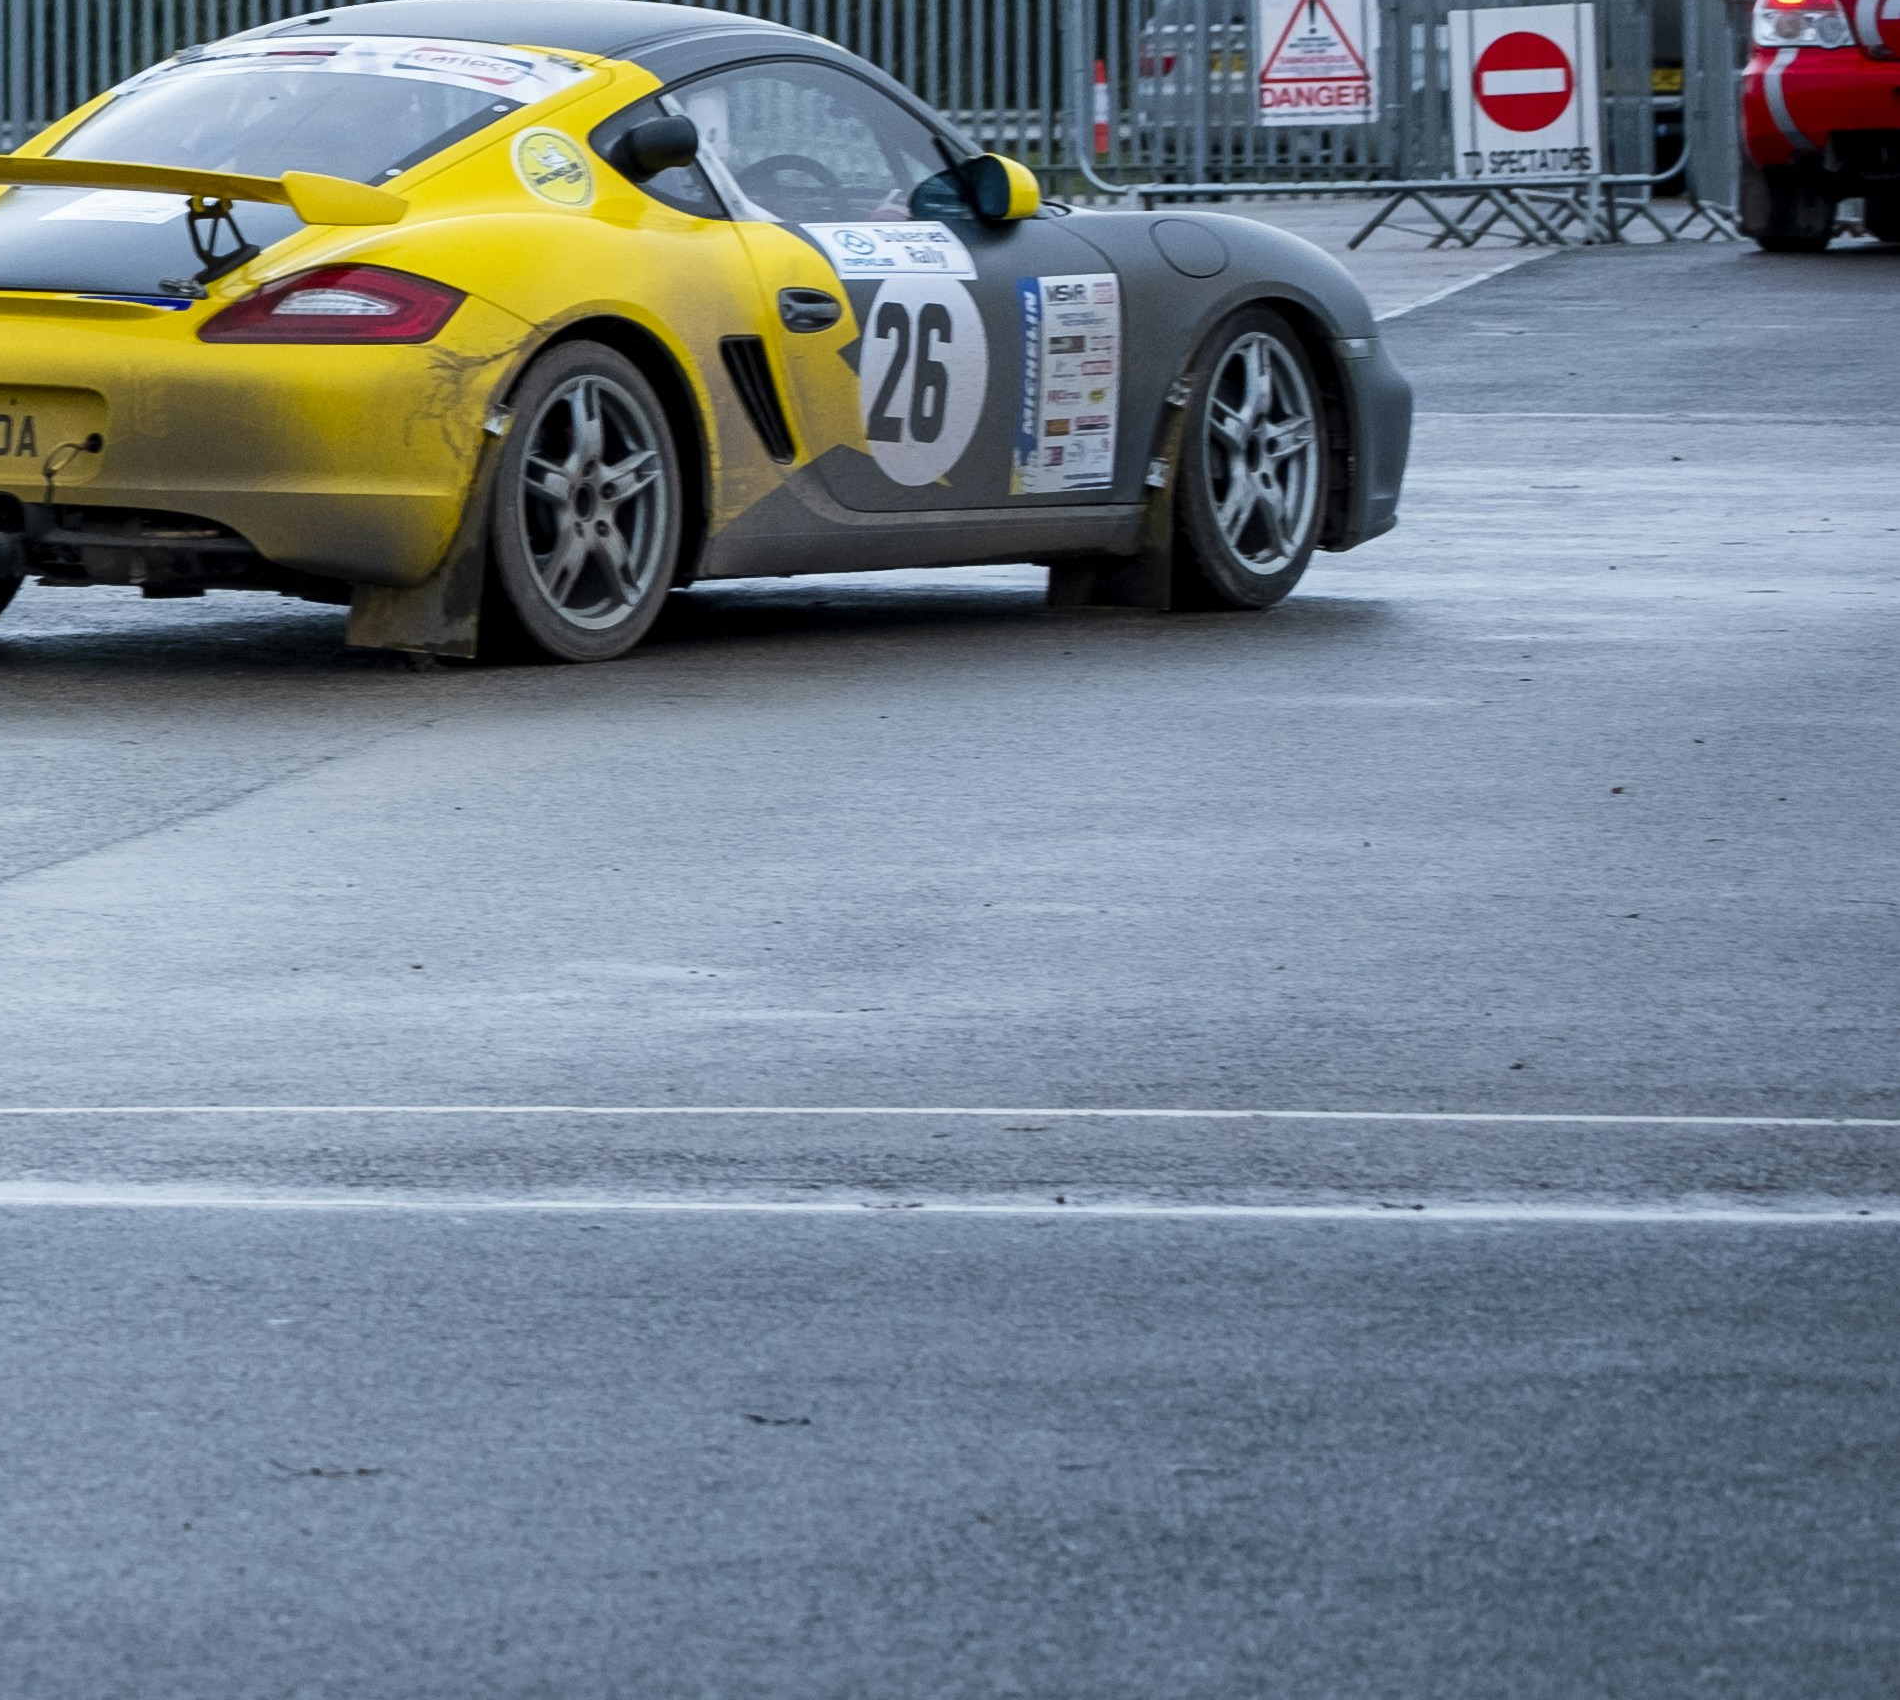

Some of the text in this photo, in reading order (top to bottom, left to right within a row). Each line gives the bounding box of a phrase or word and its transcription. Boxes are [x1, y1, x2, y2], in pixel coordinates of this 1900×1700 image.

[1260, 84, 1371, 108] DANGER
[1488, 147, 1592, 175] SPECTATORS
[872, 228, 952, 243] Dukeries
[903, 245, 949, 268] Rally
[866, 301, 953, 444] 26
[1021, 290, 1039, 434] MICHELIN
